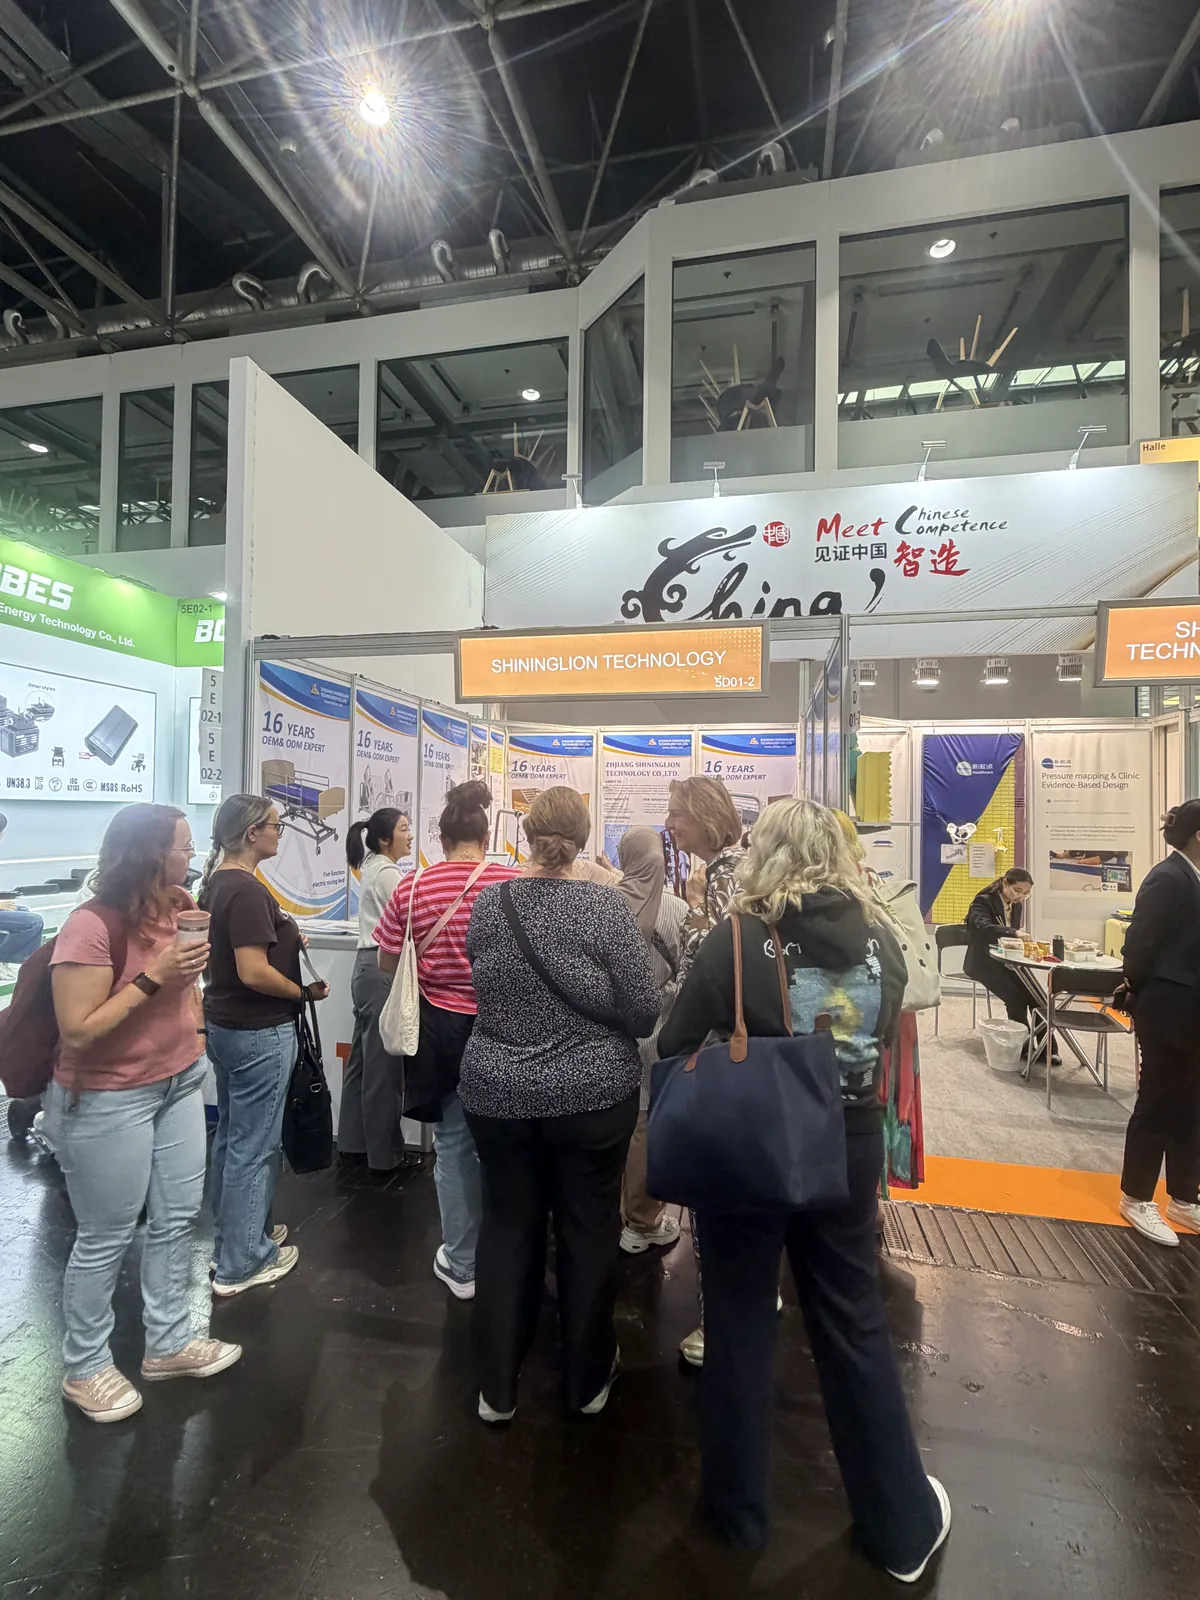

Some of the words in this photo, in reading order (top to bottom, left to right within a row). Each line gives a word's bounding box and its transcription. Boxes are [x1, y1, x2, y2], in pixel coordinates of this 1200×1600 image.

[1142, 443, 1166, 453] Halle
[816, 512, 889, 543] Meet
[814, 542, 887, 563] 见证中国
[893, 538, 972, 577] 智造
[0, 562, 75, 611] BES
[181, 604, 212, 614] 5E02-1
[39, 613, 97, 639] Technology
[98, 630, 117, 644] Co.,
[118, 635, 136, 648] Ltd.
[491, 655, 598, 673] SHININGLION
[602, 650, 727, 669] TECHNOLOGY
[210, 675, 217, 687] 5
[714, 675, 755, 688] 5D01-2
[210, 692, 216, 704] E
[201, 709, 221, 724] 02-1
[262, 710, 284, 734] 16
[287, 723, 315, 740] YEARS
[208, 733, 215, 744] 5
[262, 735, 285, 748] OEM&
[286, 739, 303, 750] ODM
[304, 742, 326, 753] EXPERT
[357, 729, 372, 749] 16
[374, 740, 393, 753] YEARS
[209, 750, 215, 762] E
[424, 743, 434, 759] 16
[435, 751, 451, 762] YEARS
[511, 760, 528, 772] 16
[531, 765, 557, 773] YEARS
[704, 760, 723, 773] 16
[726, 764, 755, 773] YEARS
[201, 768, 222, 780] 02-2
[1041, 772, 1074, 780] Pressure
[1075, 773, 1109, 781] mapping
[1110, 772, 1117, 780] &
[1117, 772, 1140, 780] Clinic
[6, 776, 31, 789] UN38.3
[121, 783, 143, 793] RoHS
[1041, 781, 1101, 789] Evidence-Based
[1102, 781, 1129, 790] Design
